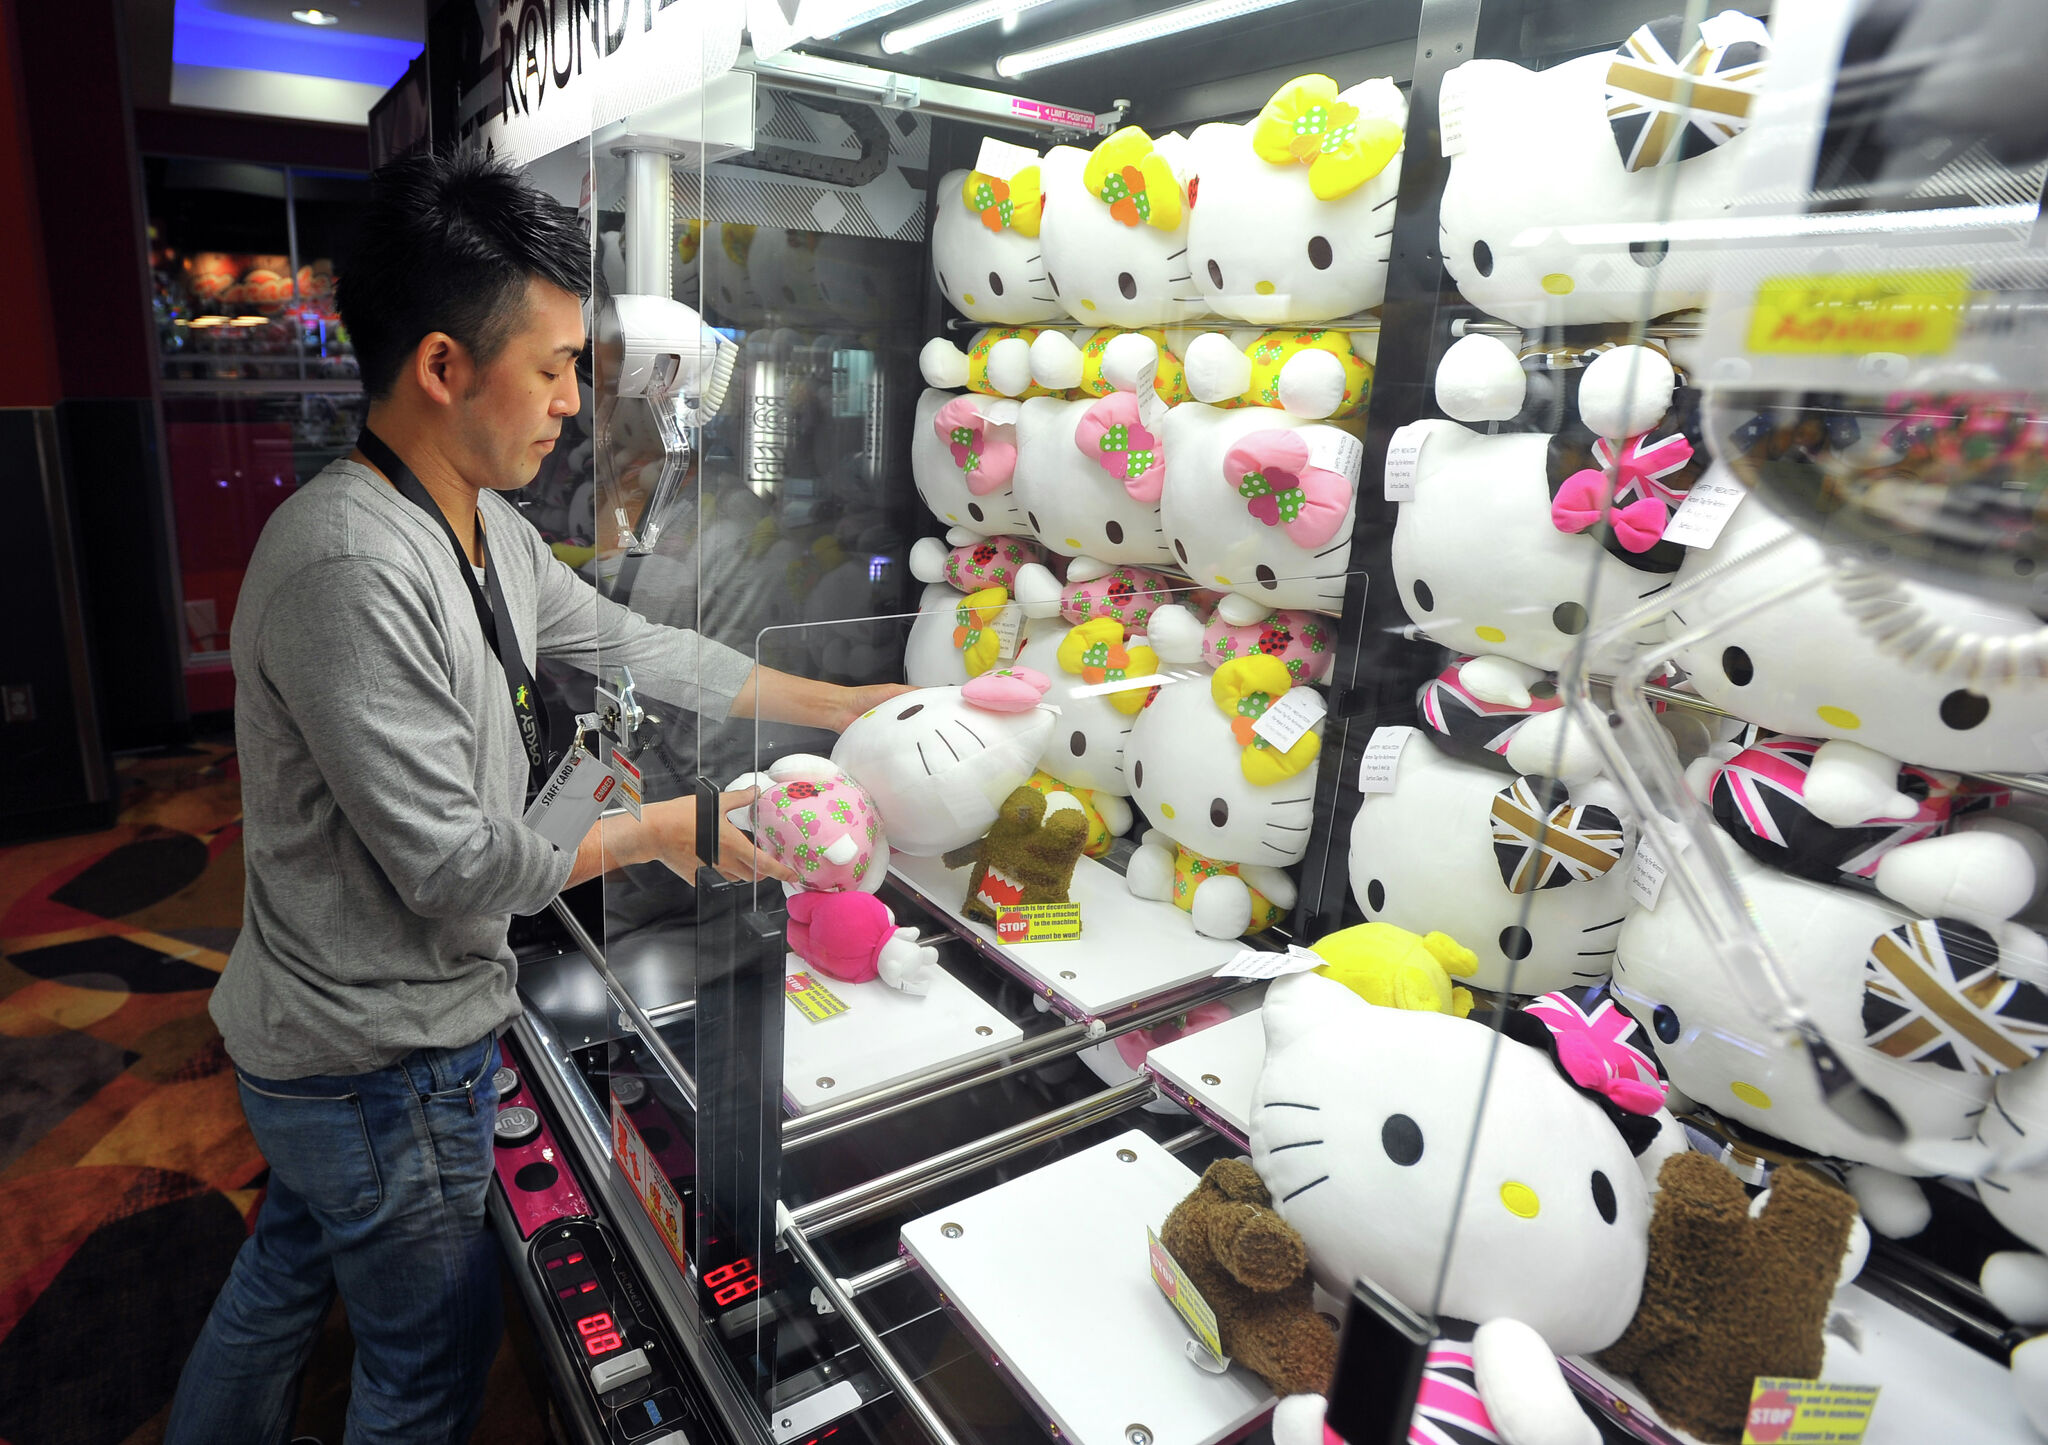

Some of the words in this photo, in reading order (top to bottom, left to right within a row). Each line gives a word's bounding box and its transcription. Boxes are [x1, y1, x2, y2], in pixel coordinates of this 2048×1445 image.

[1067, 111, 1093, 124] POSITION
[520, 714, 541, 766] OAKLEY
[541, 783, 560, 807] STAFF
[556, 764, 574, 786] CARD
[594, 777, 614, 801] EMBED
[999, 922, 1027, 932] STOP
[786, 976, 804, 990] STOP
[1750, 1407, 1793, 1424] STOP
